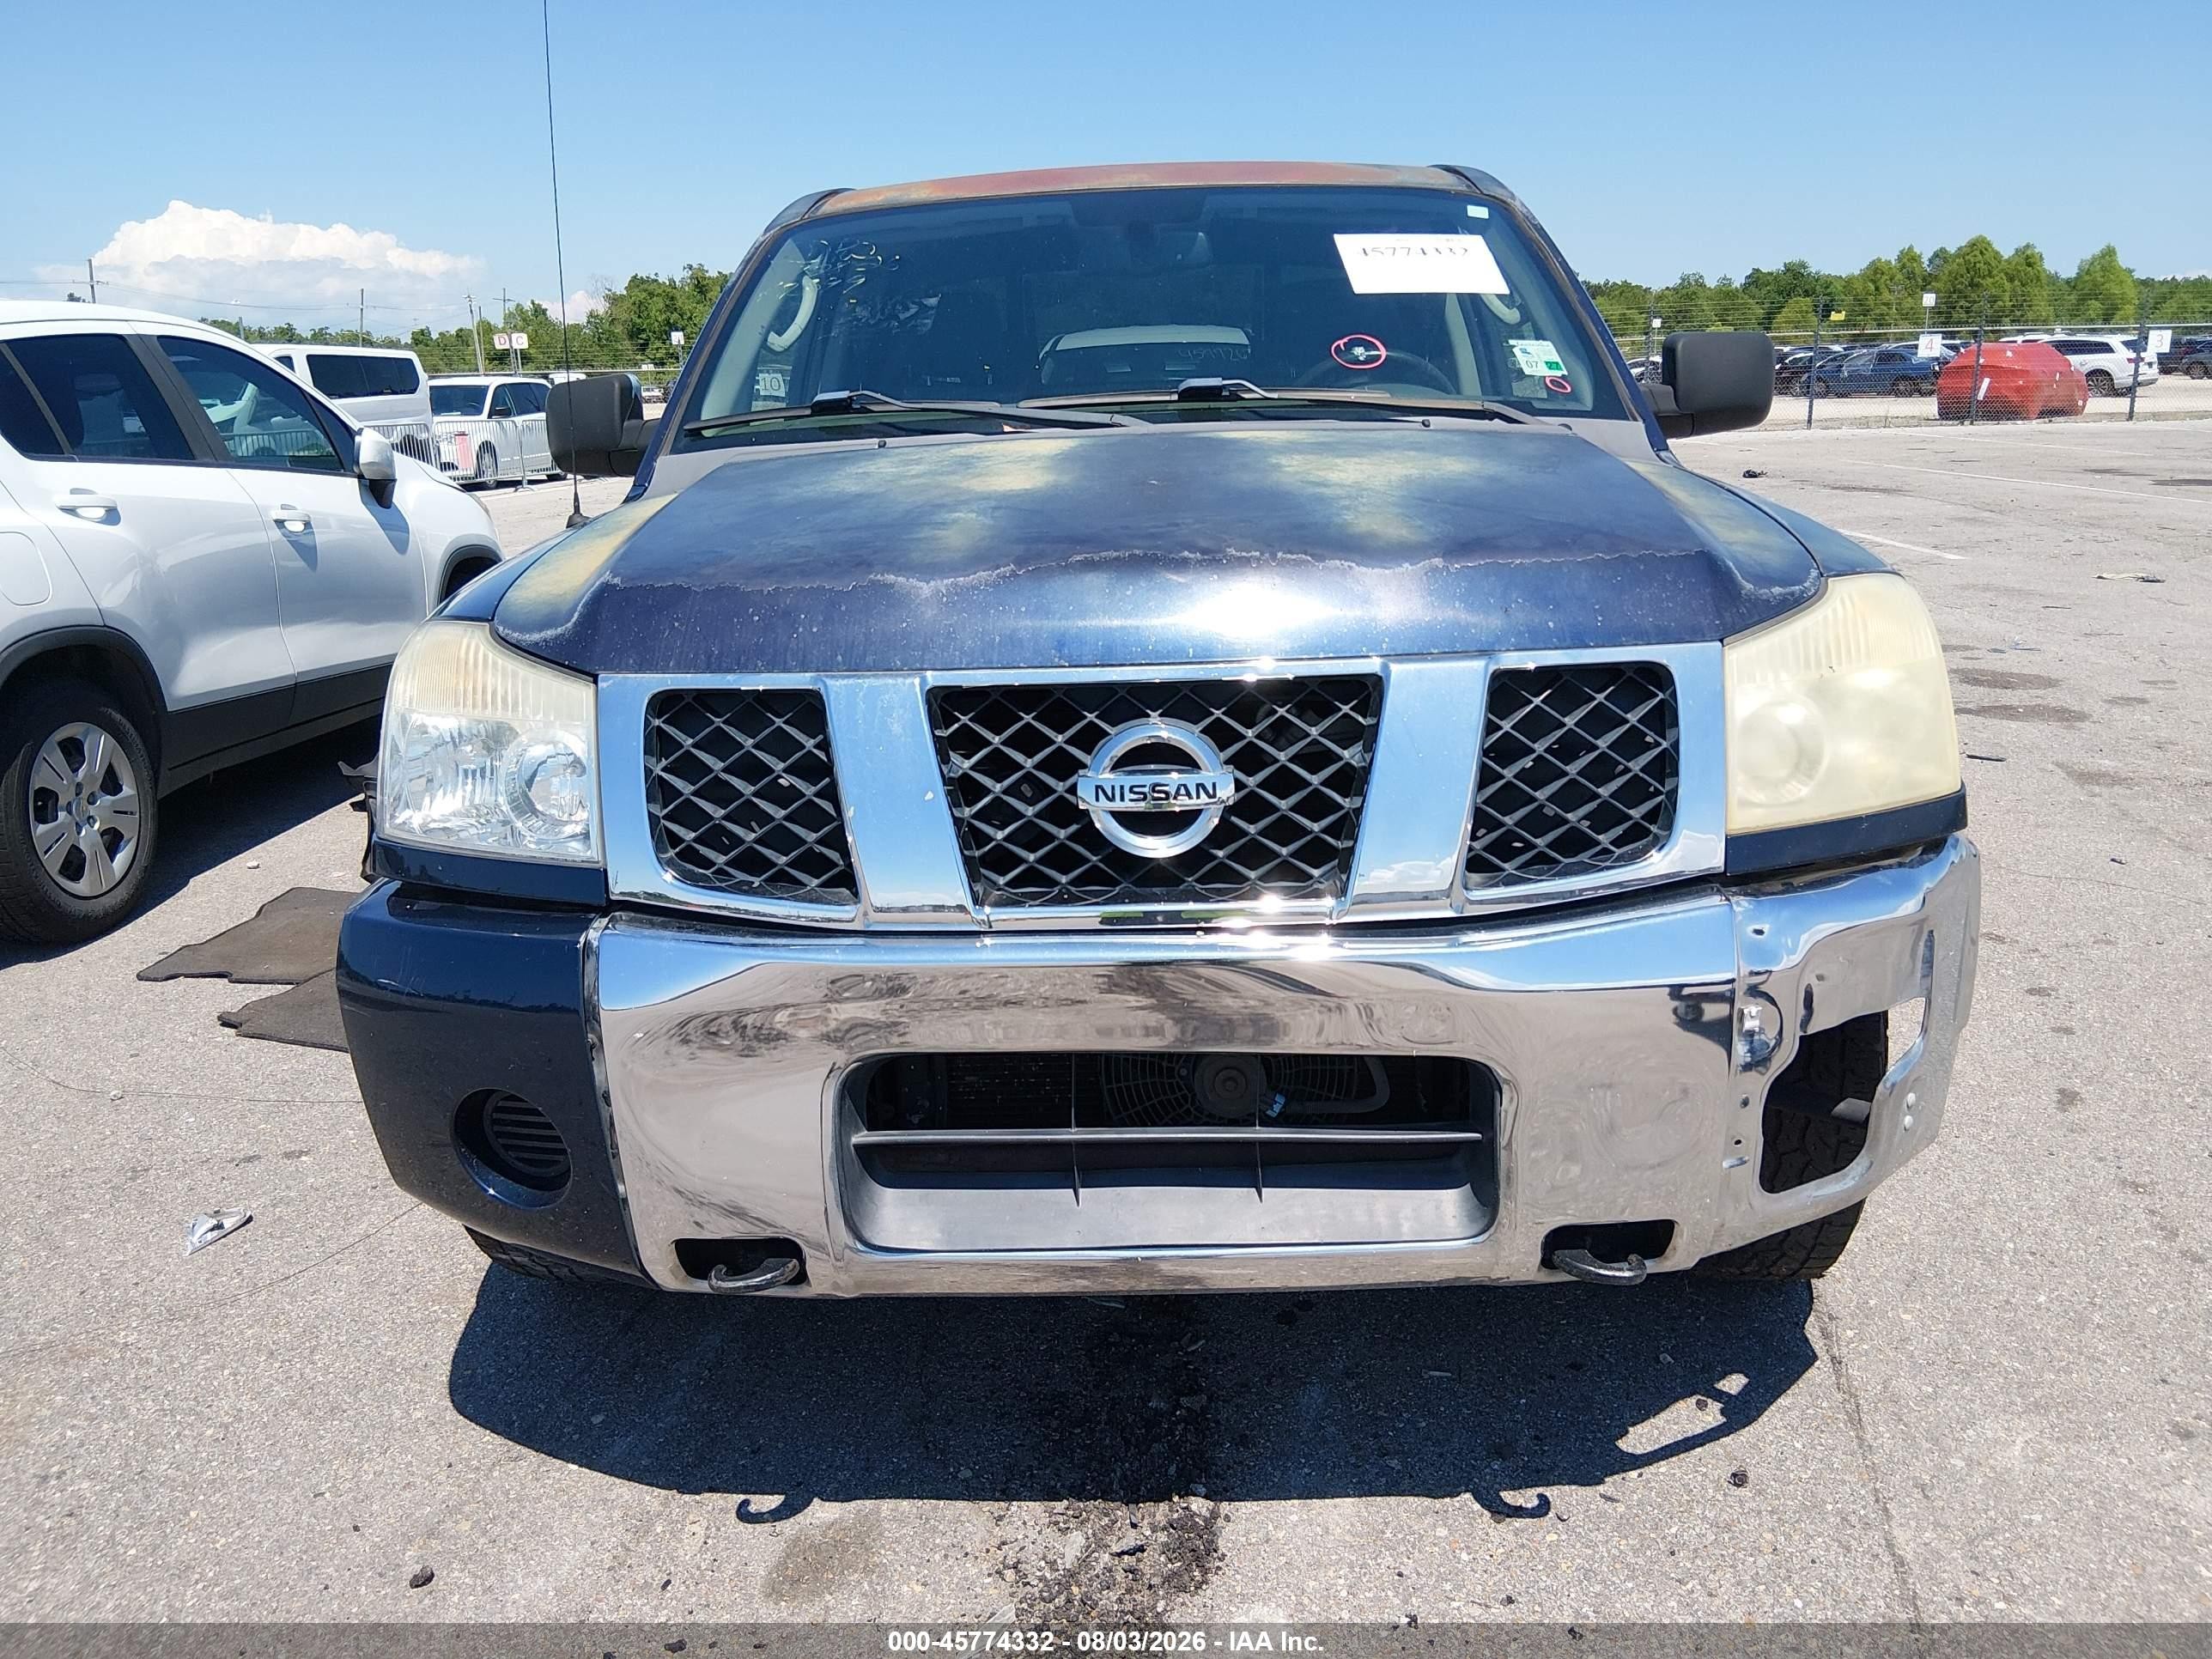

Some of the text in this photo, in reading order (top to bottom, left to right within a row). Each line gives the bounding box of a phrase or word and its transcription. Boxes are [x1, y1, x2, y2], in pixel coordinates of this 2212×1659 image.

[498, 336, 507, 345] D
[516, 336, 524, 345] C
[1925, 338, 1934, 352] 4
[2156, 334, 2164, 348] 3
[1525, 361, 1539, 369] 07
[761, 377, 781, 392] 10
[1095, 782, 1218, 802] NISSAN
